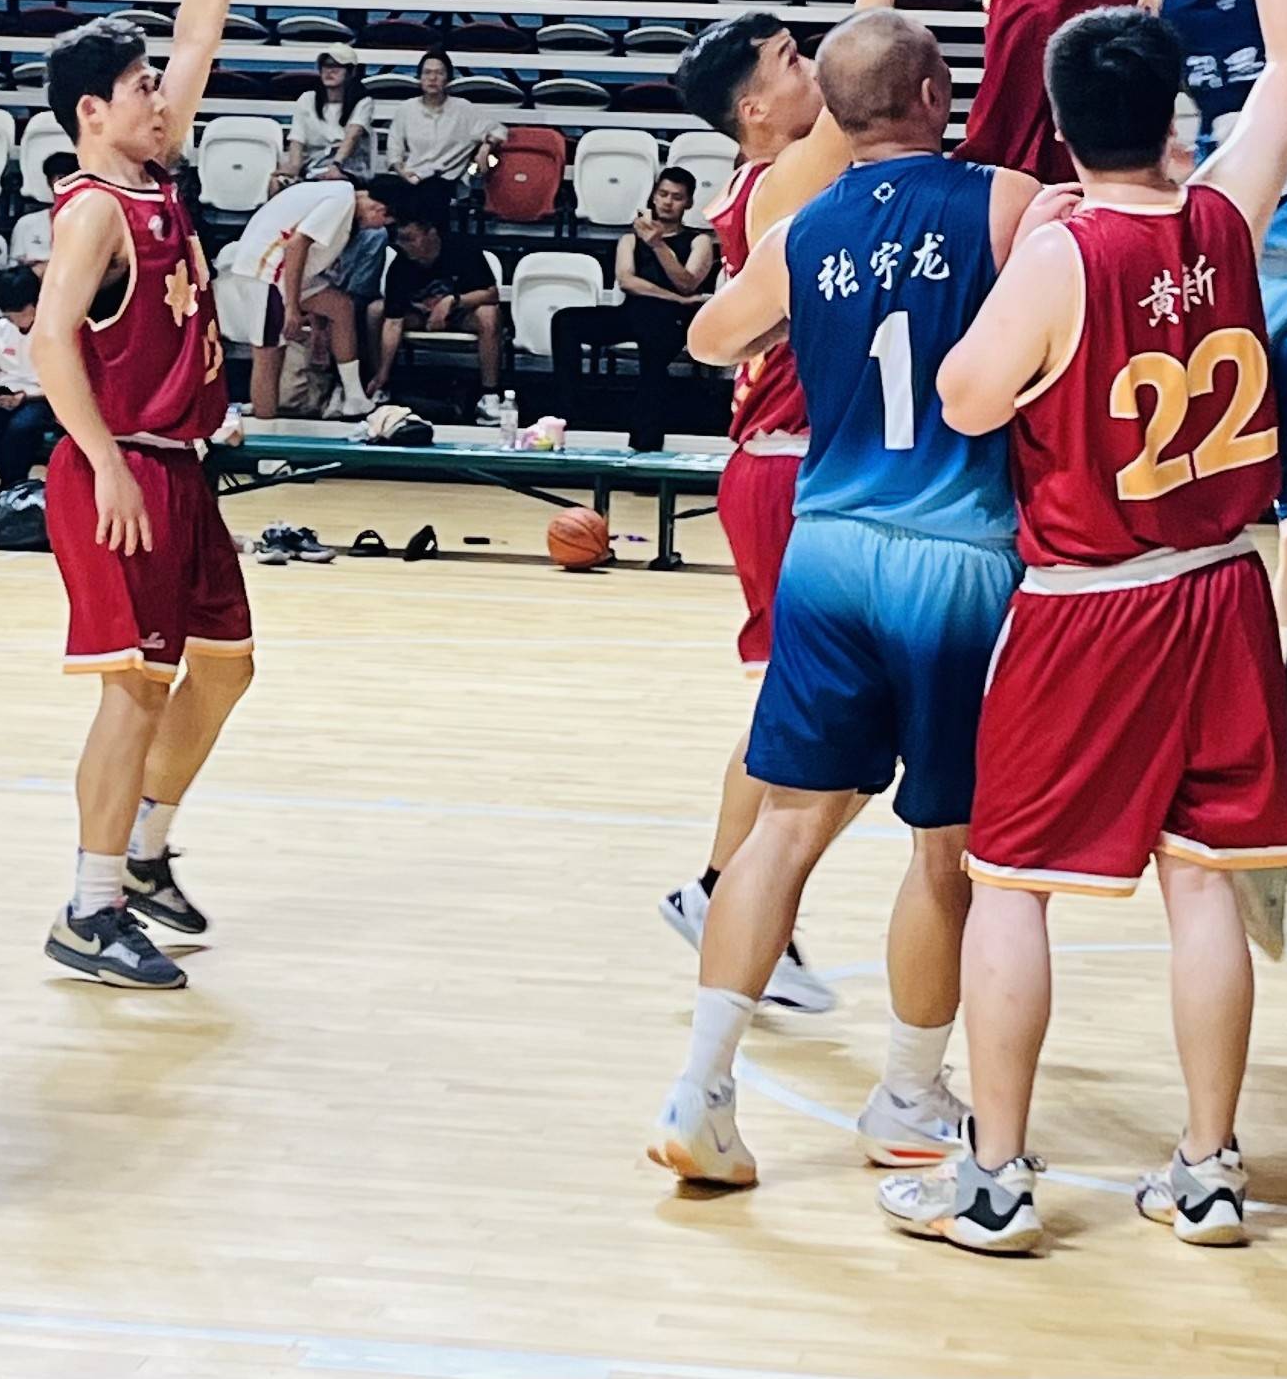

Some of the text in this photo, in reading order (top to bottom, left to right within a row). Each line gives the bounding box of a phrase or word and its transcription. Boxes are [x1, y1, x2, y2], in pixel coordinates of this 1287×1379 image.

[817, 232, 951, 302] 张宇龙
[869, 310, 915, 450] 1
[1109, 326, 1279, 501] 22
